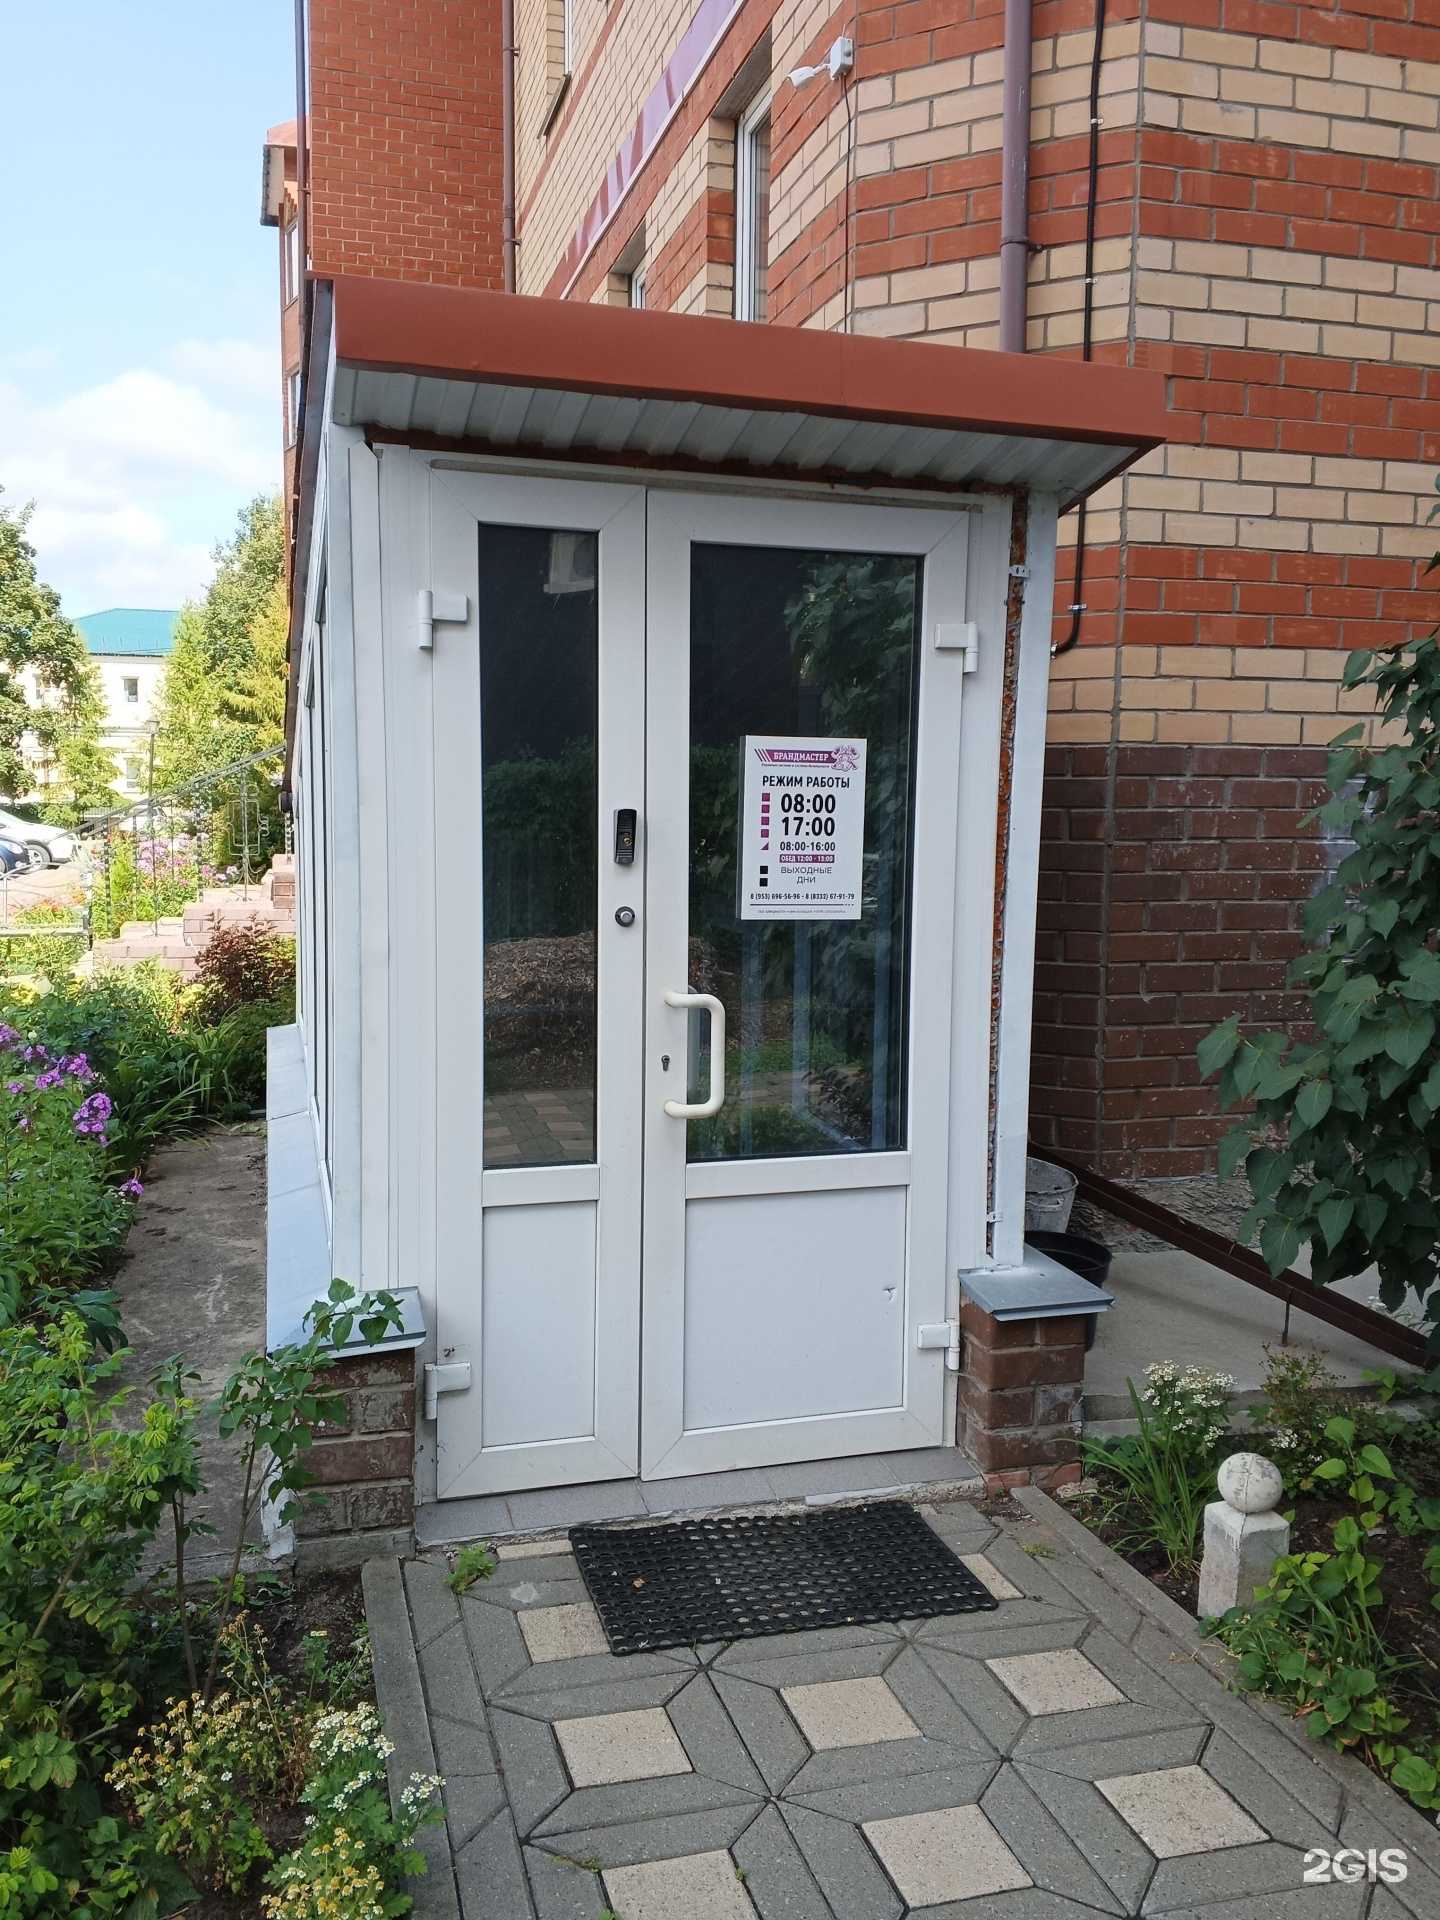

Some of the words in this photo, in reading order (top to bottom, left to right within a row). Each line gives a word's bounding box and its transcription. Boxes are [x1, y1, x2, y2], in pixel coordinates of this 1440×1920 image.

[773, 752, 829, 762] БРАНДМАСТЕР
[762, 775, 803, 787] РЕЖИМ
[806, 776, 850, 789] РАБОТЫ
[781, 793, 836, 814] 08:00
[781, 816, 836, 837] 17:00
[780, 841, 836, 852] 08:00-16:00
[781, 866, 832, 875] ВЫХОДНЫЕ
[796, 876, 816, 885] ДНИ
[755, 893, 771, 901] (953)
